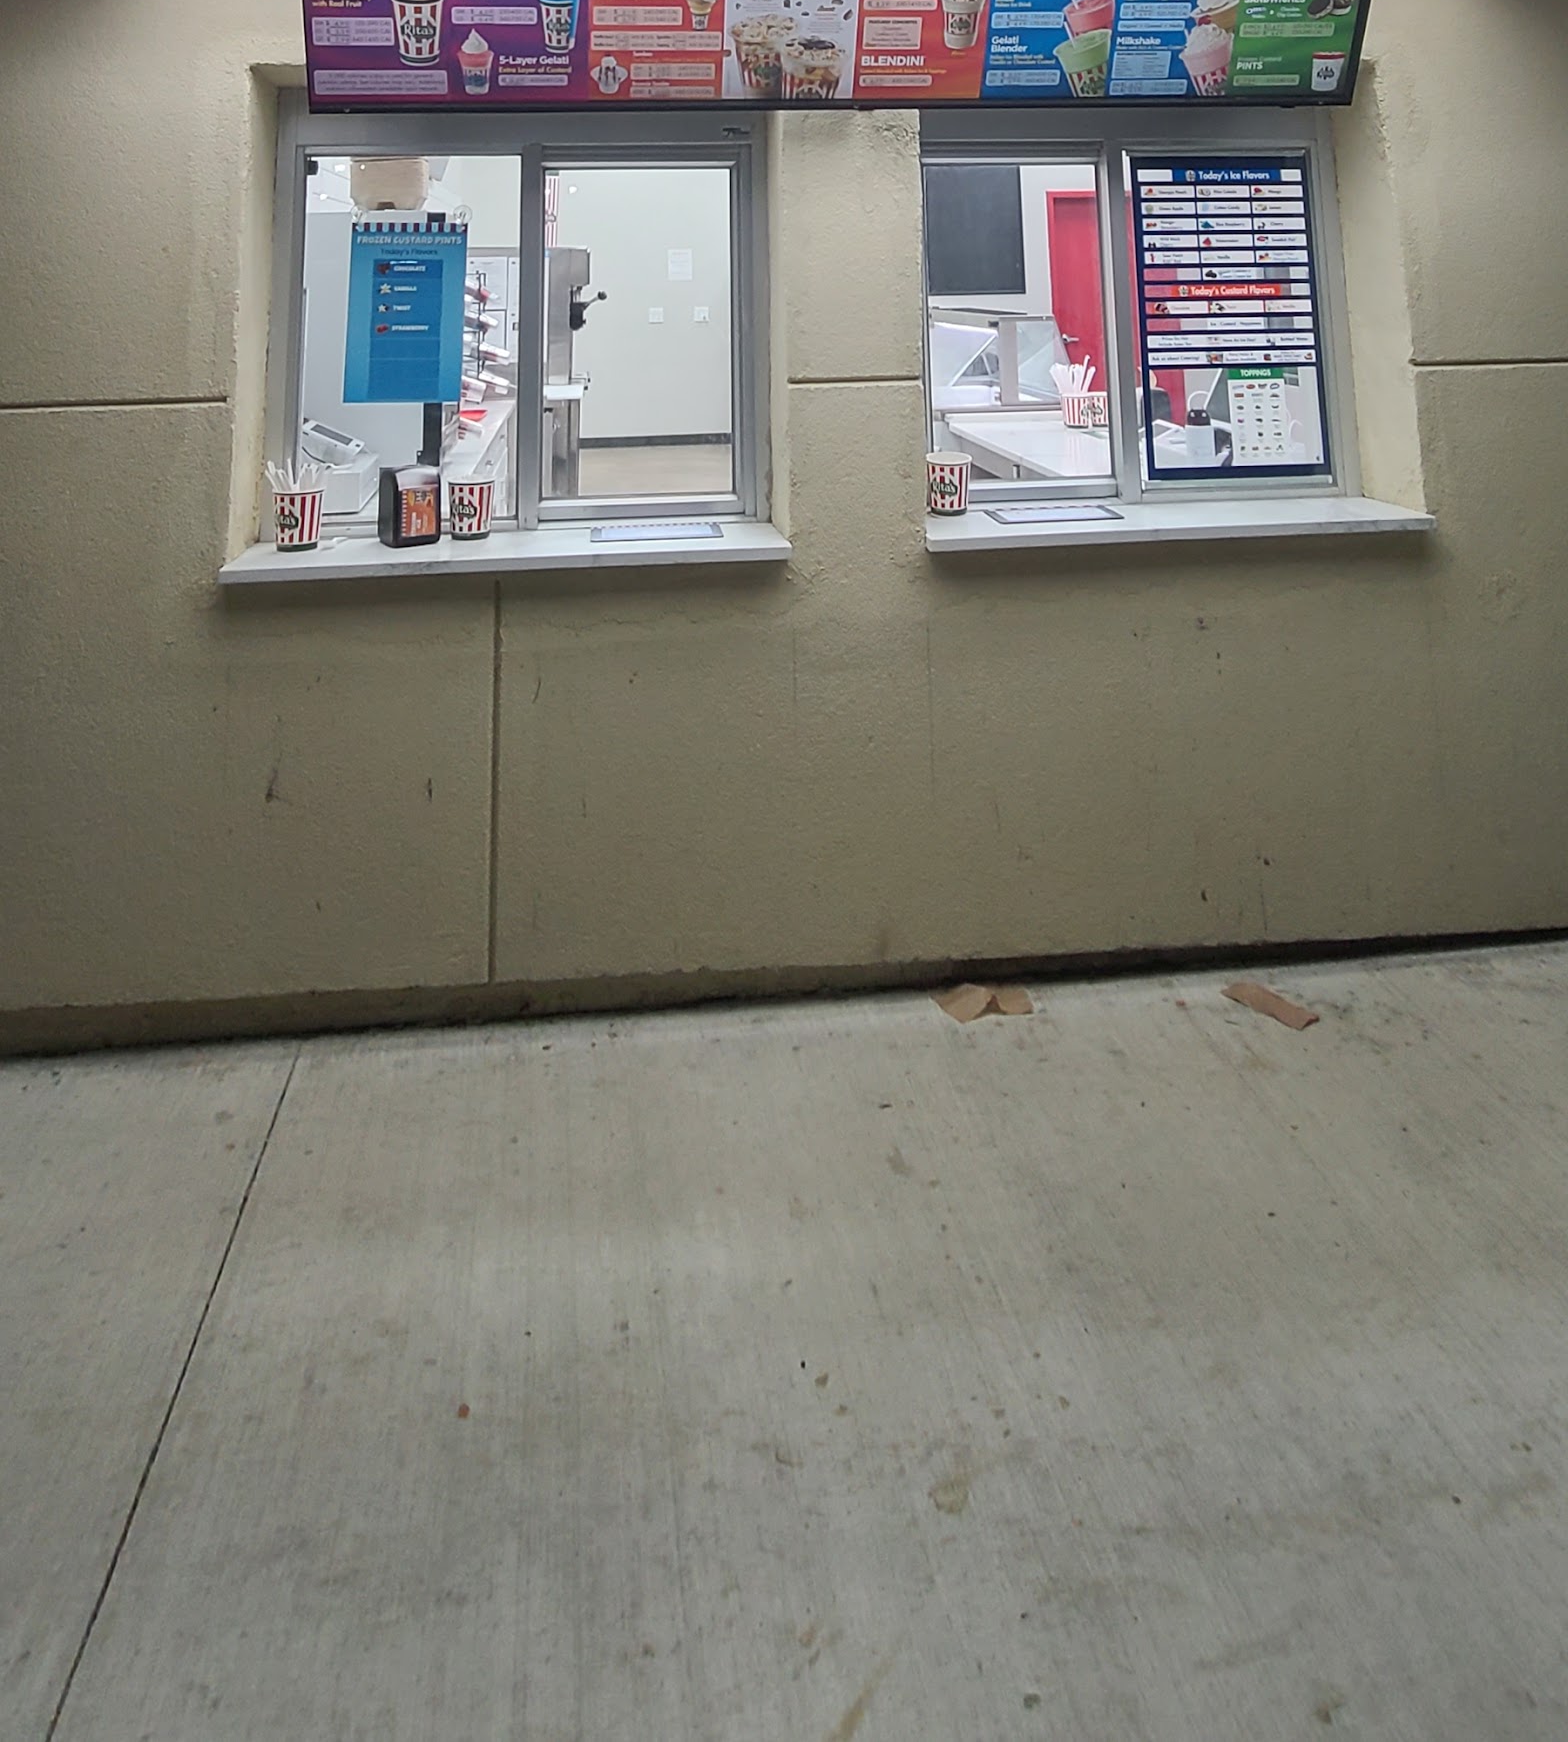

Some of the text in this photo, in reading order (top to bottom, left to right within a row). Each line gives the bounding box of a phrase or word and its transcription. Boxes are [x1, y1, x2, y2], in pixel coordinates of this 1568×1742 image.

[346, 0, 362, 7] Fruit
[403, 23, 435, 36] Rita's
[991, 35, 1020, 45] Gelati
[1116, 36, 1161, 46] Milkshake
[990, 44, 1028, 53] Blender
[539, 55, 570, 65] Gelati
[861, 55, 925, 67] BLENDINI
[1236, 61, 1263, 70] PINTS
[1198, 169, 1270, 182] Today's Ice Flavors
[356, 235, 462, 245] FROZEN CUSTARD PINTS
[1190, 284, 1275, 297] Today's Custard Flavors
[1240, 368, 1272, 377] TOPPINGS
